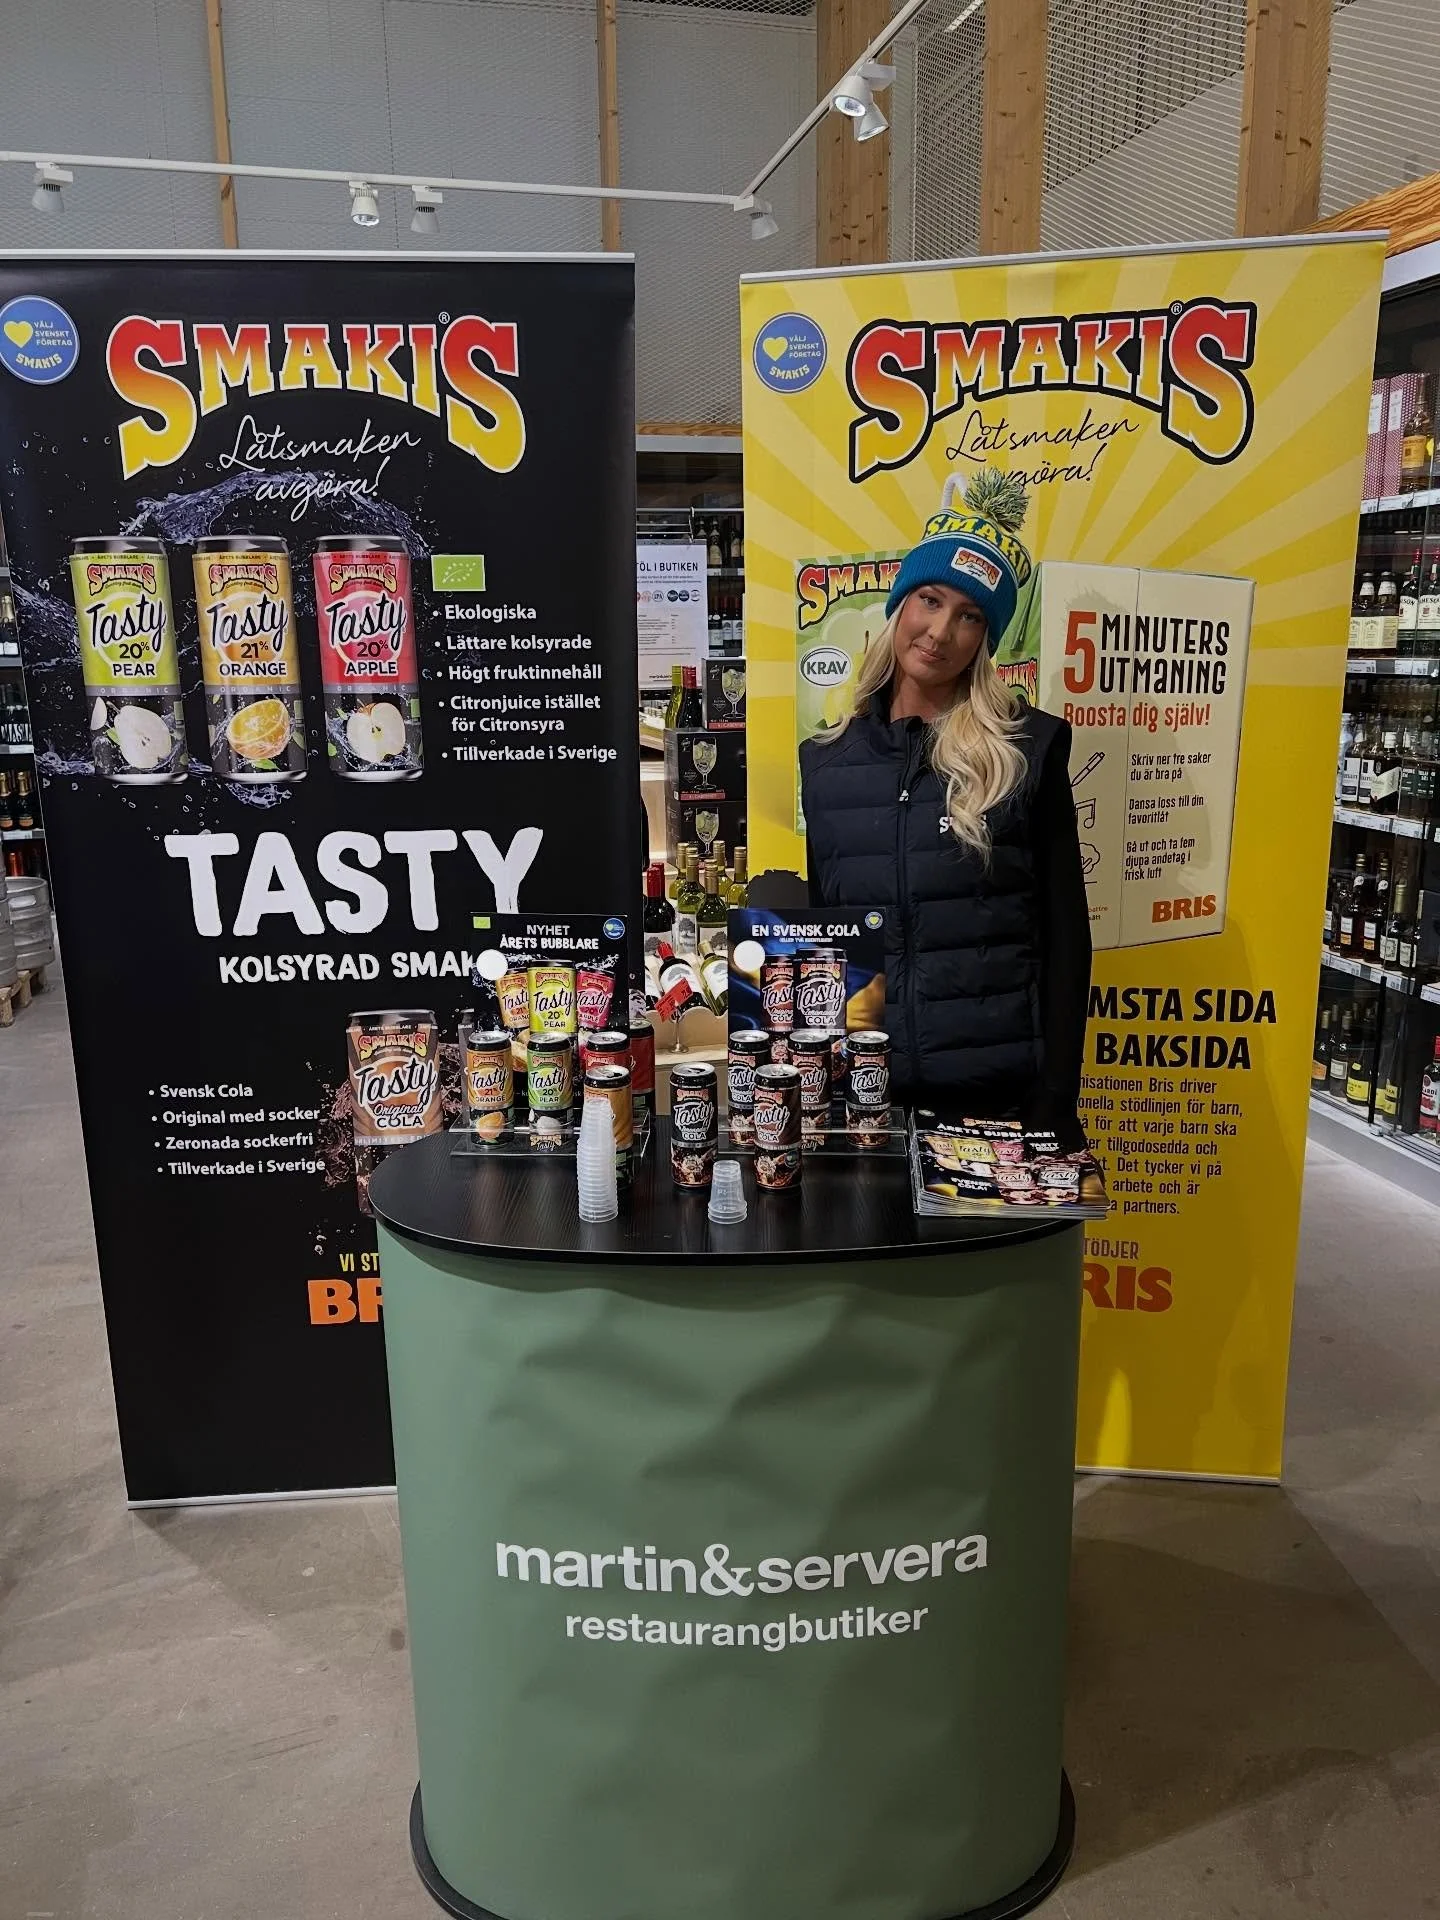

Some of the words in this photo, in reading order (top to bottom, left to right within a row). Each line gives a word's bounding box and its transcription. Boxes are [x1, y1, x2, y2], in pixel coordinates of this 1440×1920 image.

[35, 330, 70, 338] SVENSKT
[36, 338, 73, 346] FÖRETAG
[15, 352, 62, 369] SMAKIS
[769, 364, 810, 380] SMAKIS
[106, 315, 526, 480] SMAKIS
[849, 301, 1253, 481] SMAKIS
[1007, 443, 1106, 491] göra!
[256, 456, 390, 521] avgöra!
[637, 561, 652, 571] ÖL
[660, 562, 698, 571] BUTIKEN
[798, 560, 901, 629] SMAK
[86, 594, 166, 652] Tasty
[207, 593, 288, 651] Tasty
[326, 592, 406, 651] Tasty
[445, 604, 537, 623] Ekologiska
[119, 641, 149, 659] 20%
[241, 641, 268, 659] 21%
[357, 639, 388, 657] 20%
[447, 635, 506, 650] Lättare
[511, 634, 592, 653] kolsyrade
[1064, 610, 1096, 694] 5
[1101, 613, 1230, 656] MINUTERS
[113, 664, 155, 676] PEAR
[220, 663, 286, 675] ORANGE
[346, 662, 397, 674] APPLE
[449, 665, 490, 683] Högt
[494, 664, 602, 680] fruktinnehåll
[806, 661, 847, 675] KRAV
[450, 695, 541, 713] Citronjuice
[545, 694, 601, 709] istället
[452, 717, 476, 732] för
[479, 717, 565, 734] Citronsyra
[1064, 702, 1126, 727] Boosta
[1133, 702, 1158, 733] dig
[1165, 702, 1211, 732] själv!
[453, 746, 545, 761] Tillverkade
[549, 746, 554, 760] i
[558, 745, 617, 763] Sverige
[1131, 753, 1154, 766] Skriv
[1157, 755, 1171, 765] ner
[1172, 754, 1185, 765] tre
[1187, 752, 1211, 764] saker
[1131, 770, 1142, 781] du
[1144, 769, 1153, 780] är
[1155, 769, 1170, 780] bra
[1171, 768, 1182, 782] på
[1129, 798, 1156, 811] Dansa
[1158, 796, 1176, 809] loss
[1179, 795, 1190, 807] till
[1191, 795, 1204, 807] din
[1128, 811, 1169, 824] favoritlåt
[1126, 839, 1137, 853] Gå
[1139, 840, 1149, 851] ut
[1151, 839, 1167, 851] och
[1169, 838, 1178, 850] ta
[1180, 837, 1195, 848] fem
[1126, 854, 1150, 868] djupa
[1151, 852, 1186, 865] andetag
[164, 827, 544, 937] TASTY
[1125, 868, 1145, 880] frisk
[1147, 867, 1162, 879] luft
[1152, 895, 1216, 923] BRIS
[526, 925, 570, 936] NYHET
[752, 925, 769, 937] EN
[773, 924, 823, 937] SVENSK
[827, 924, 860, 937] COLA
[500, 934, 537, 949] ÅRETS
[540, 937, 599, 949] BUBBLARE
[219, 953, 380, 983] KOLSYRAD
[391, 951, 474, 978] SMAK
[534, 988, 574, 1016] Tasty
[577, 991, 611, 1012] Tasty
[796, 980, 845, 1009] Tasty
[1087, 986, 1184, 1021] MSTA
[1193, 988, 1277, 1023] SIDA
[1096, 1032, 1252, 1069] BAKSIDA
[355, 1057, 437, 1106] Tasty
[472, 1069, 509, 1091] Tasty
[531, 1068, 568, 1091] Tasty
[851, 1067, 889, 1093] Tasty
[1080, 1074, 1143, 1091] nisationen
[1149, 1077, 1174, 1092] Bris
[1180, 1079, 1218, 1094] driver
[160, 1084, 215, 1098] Svensk
[218, 1083, 253, 1097] Cola
[859, 1095, 882, 1103] COLA
[374, 1103, 423, 1118] Original
[674, 1101, 714, 1129] Tasty
[1078, 1095, 1114, 1111] onella
[1120, 1097, 1181, 1117] stödlinjen
[1187, 1100, 1206, 1114] för
[1211, 1101, 1243, 1118] barn,
[163, 1110, 225, 1127] Original
[230, 1109, 265, 1123] med
[268, 1107, 320, 1121] socker
[377, 1116, 423, 1128] COLA
[684, 1132, 706, 1140] COLA
[937, 1122, 980, 1135] ÅRETS
[1095, 1117, 1113, 1131] för
[1119, 1118, 1138, 1133] att
[1144, 1120, 1174, 1137] varje
[1180, 1120, 1208, 1135] barn
[1214, 1121, 1237, 1136] ska
[165, 1136, 240, 1150] Zeronada
[244, 1132, 314, 1148] sockerfri
[1107, 1137, 1189, 1156] tillgodosedda
[1195, 1141, 1218, 1155] och
[168, 1161, 255, 1175] Tillverkade
[258, 1160, 263, 1173] i
[266, 1158, 326, 1174] Sverige
[1117, 1158, 1139, 1173] Det
[1145, 1160, 1184, 1177] tycker
[1190, 1160, 1201, 1175] vi
[1206, 1161, 1222, 1179] på
[1112, 1178, 1153, 1194] arbete
[1159, 1180, 1180, 1194] och
[1187, 1180, 1201, 1195] är
[1123, 1199, 1180, 1215] partners.
[1083, 1237, 1139, 1260] TÖDJER
[339, 1253, 355, 1272] VI
[361, 1252, 379, 1272] ST
[1083, 1262, 1173, 1313] RIS
[308, 1278, 383, 1324] BR
[496, 1534, 988, 1597] martin&servera
[566, 1605, 929, 1652] restaurangbutiker
